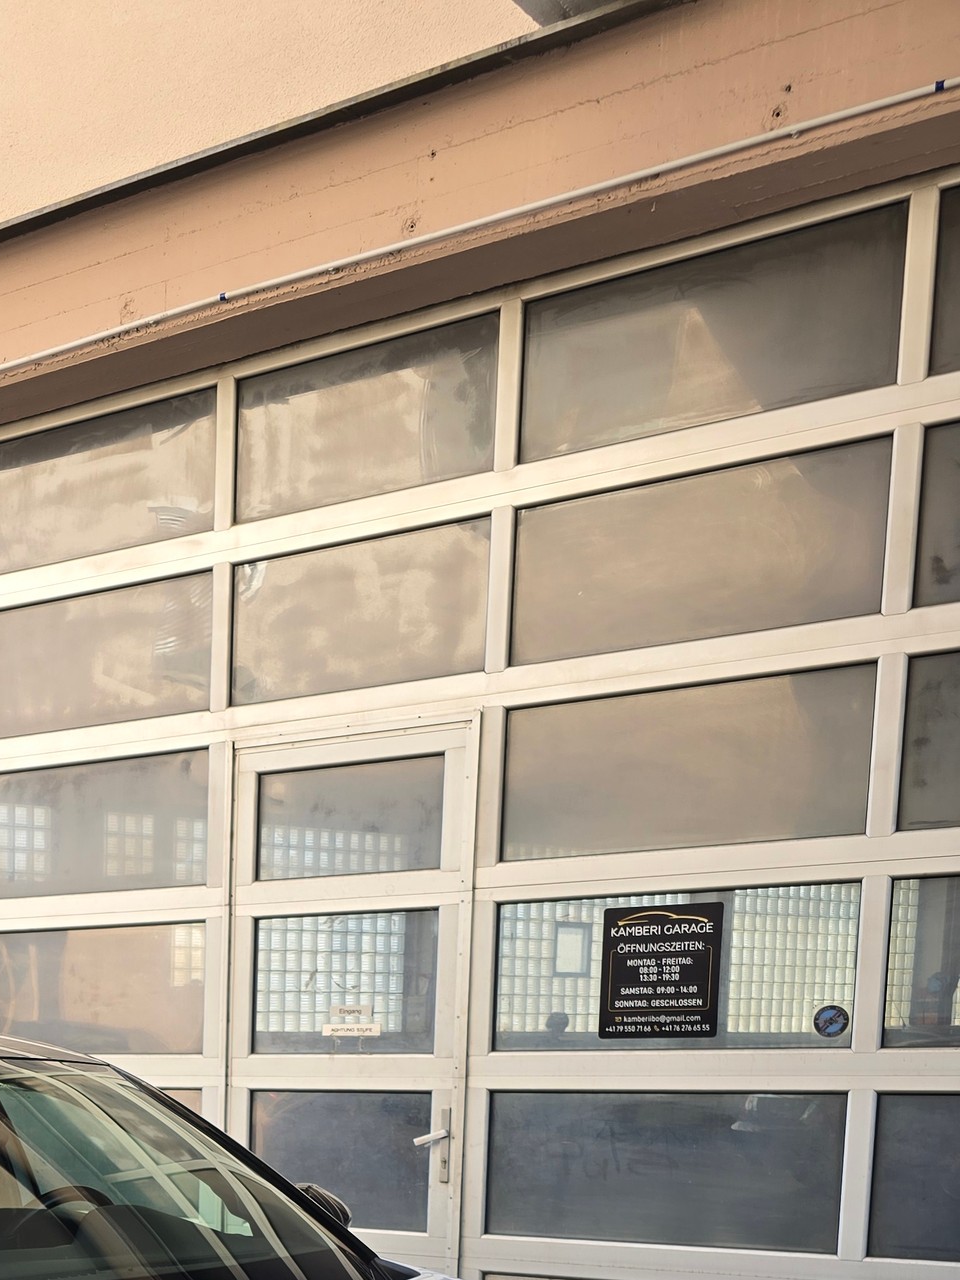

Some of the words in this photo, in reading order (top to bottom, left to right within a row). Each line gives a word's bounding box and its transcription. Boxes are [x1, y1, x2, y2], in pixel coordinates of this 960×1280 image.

[610, 925, 661, 937] KAMBERI
[663, 922, 714, 935] GARAGE
[617, 941, 705, 954] ÖFFNUNGSZEITEN:
[626, 958, 656, 967] MONTAG
[662, 957, 693, 966] FREITAG:
[638, 966, 657, 974] 08:00
[662, 965, 680, 973] 12:00
[639, 974, 657, 982] 13:30
[662, 973, 680, 981] 19:30
[620, 987, 655, 995] SAMSTAG:
[656, 986, 675, 994] 09:00
[680, 985, 698, 993] 14:00
[614, 1000, 649, 1008] SONNTAG:
[650, 998, 703, 1007] GESCHLOSSEN
